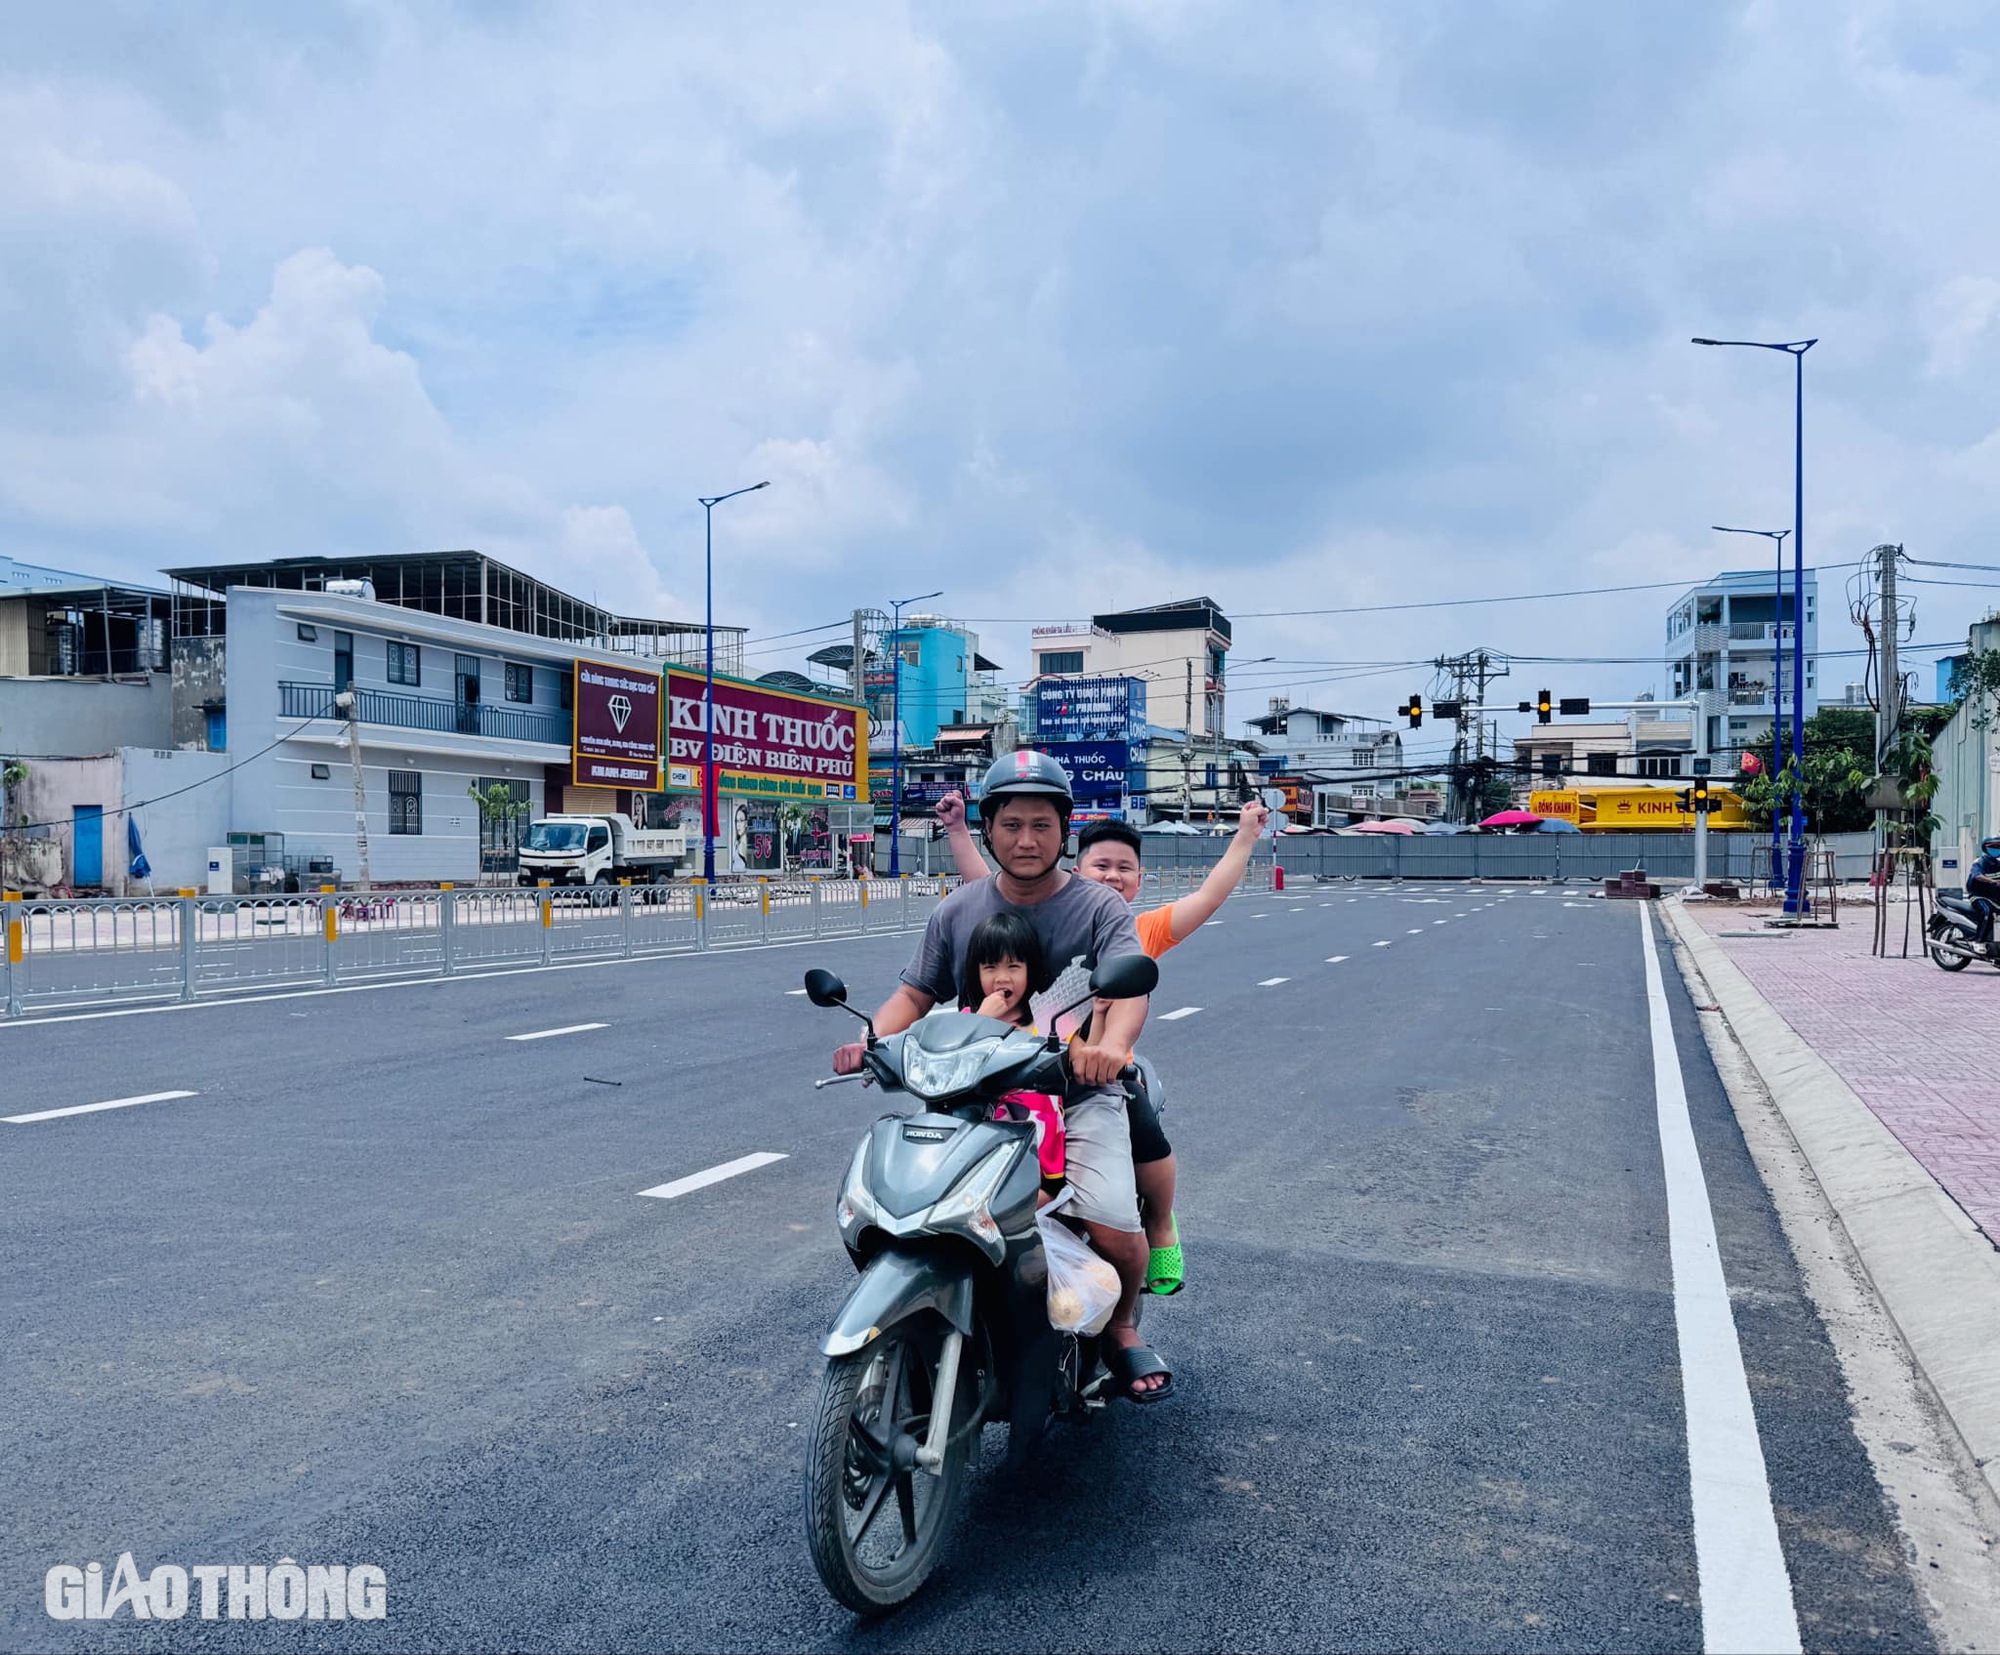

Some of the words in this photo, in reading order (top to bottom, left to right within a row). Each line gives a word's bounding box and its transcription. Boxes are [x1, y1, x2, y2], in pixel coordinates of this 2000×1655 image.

[1041, 688, 1063, 700] CÔNG
[1065, 689, 1074, 699] TY
[670, 687, 758, 740] KÍNH
[762, 709, 855, 752] THUỐC
[670, 737, 704, 759] BV
[712, 742, 762, 769] ĐIỆN
[764, 748, 815, 772] BIÊN
[816, 754, 854, 776] PHỦ
[1074, 751, 1106, 764] THUỐC
[1082, 765, 1124, 781] CHÂU
[1638, 802, 1672, 814] KINH
[906, 1130, 943, 1139] HONDA
